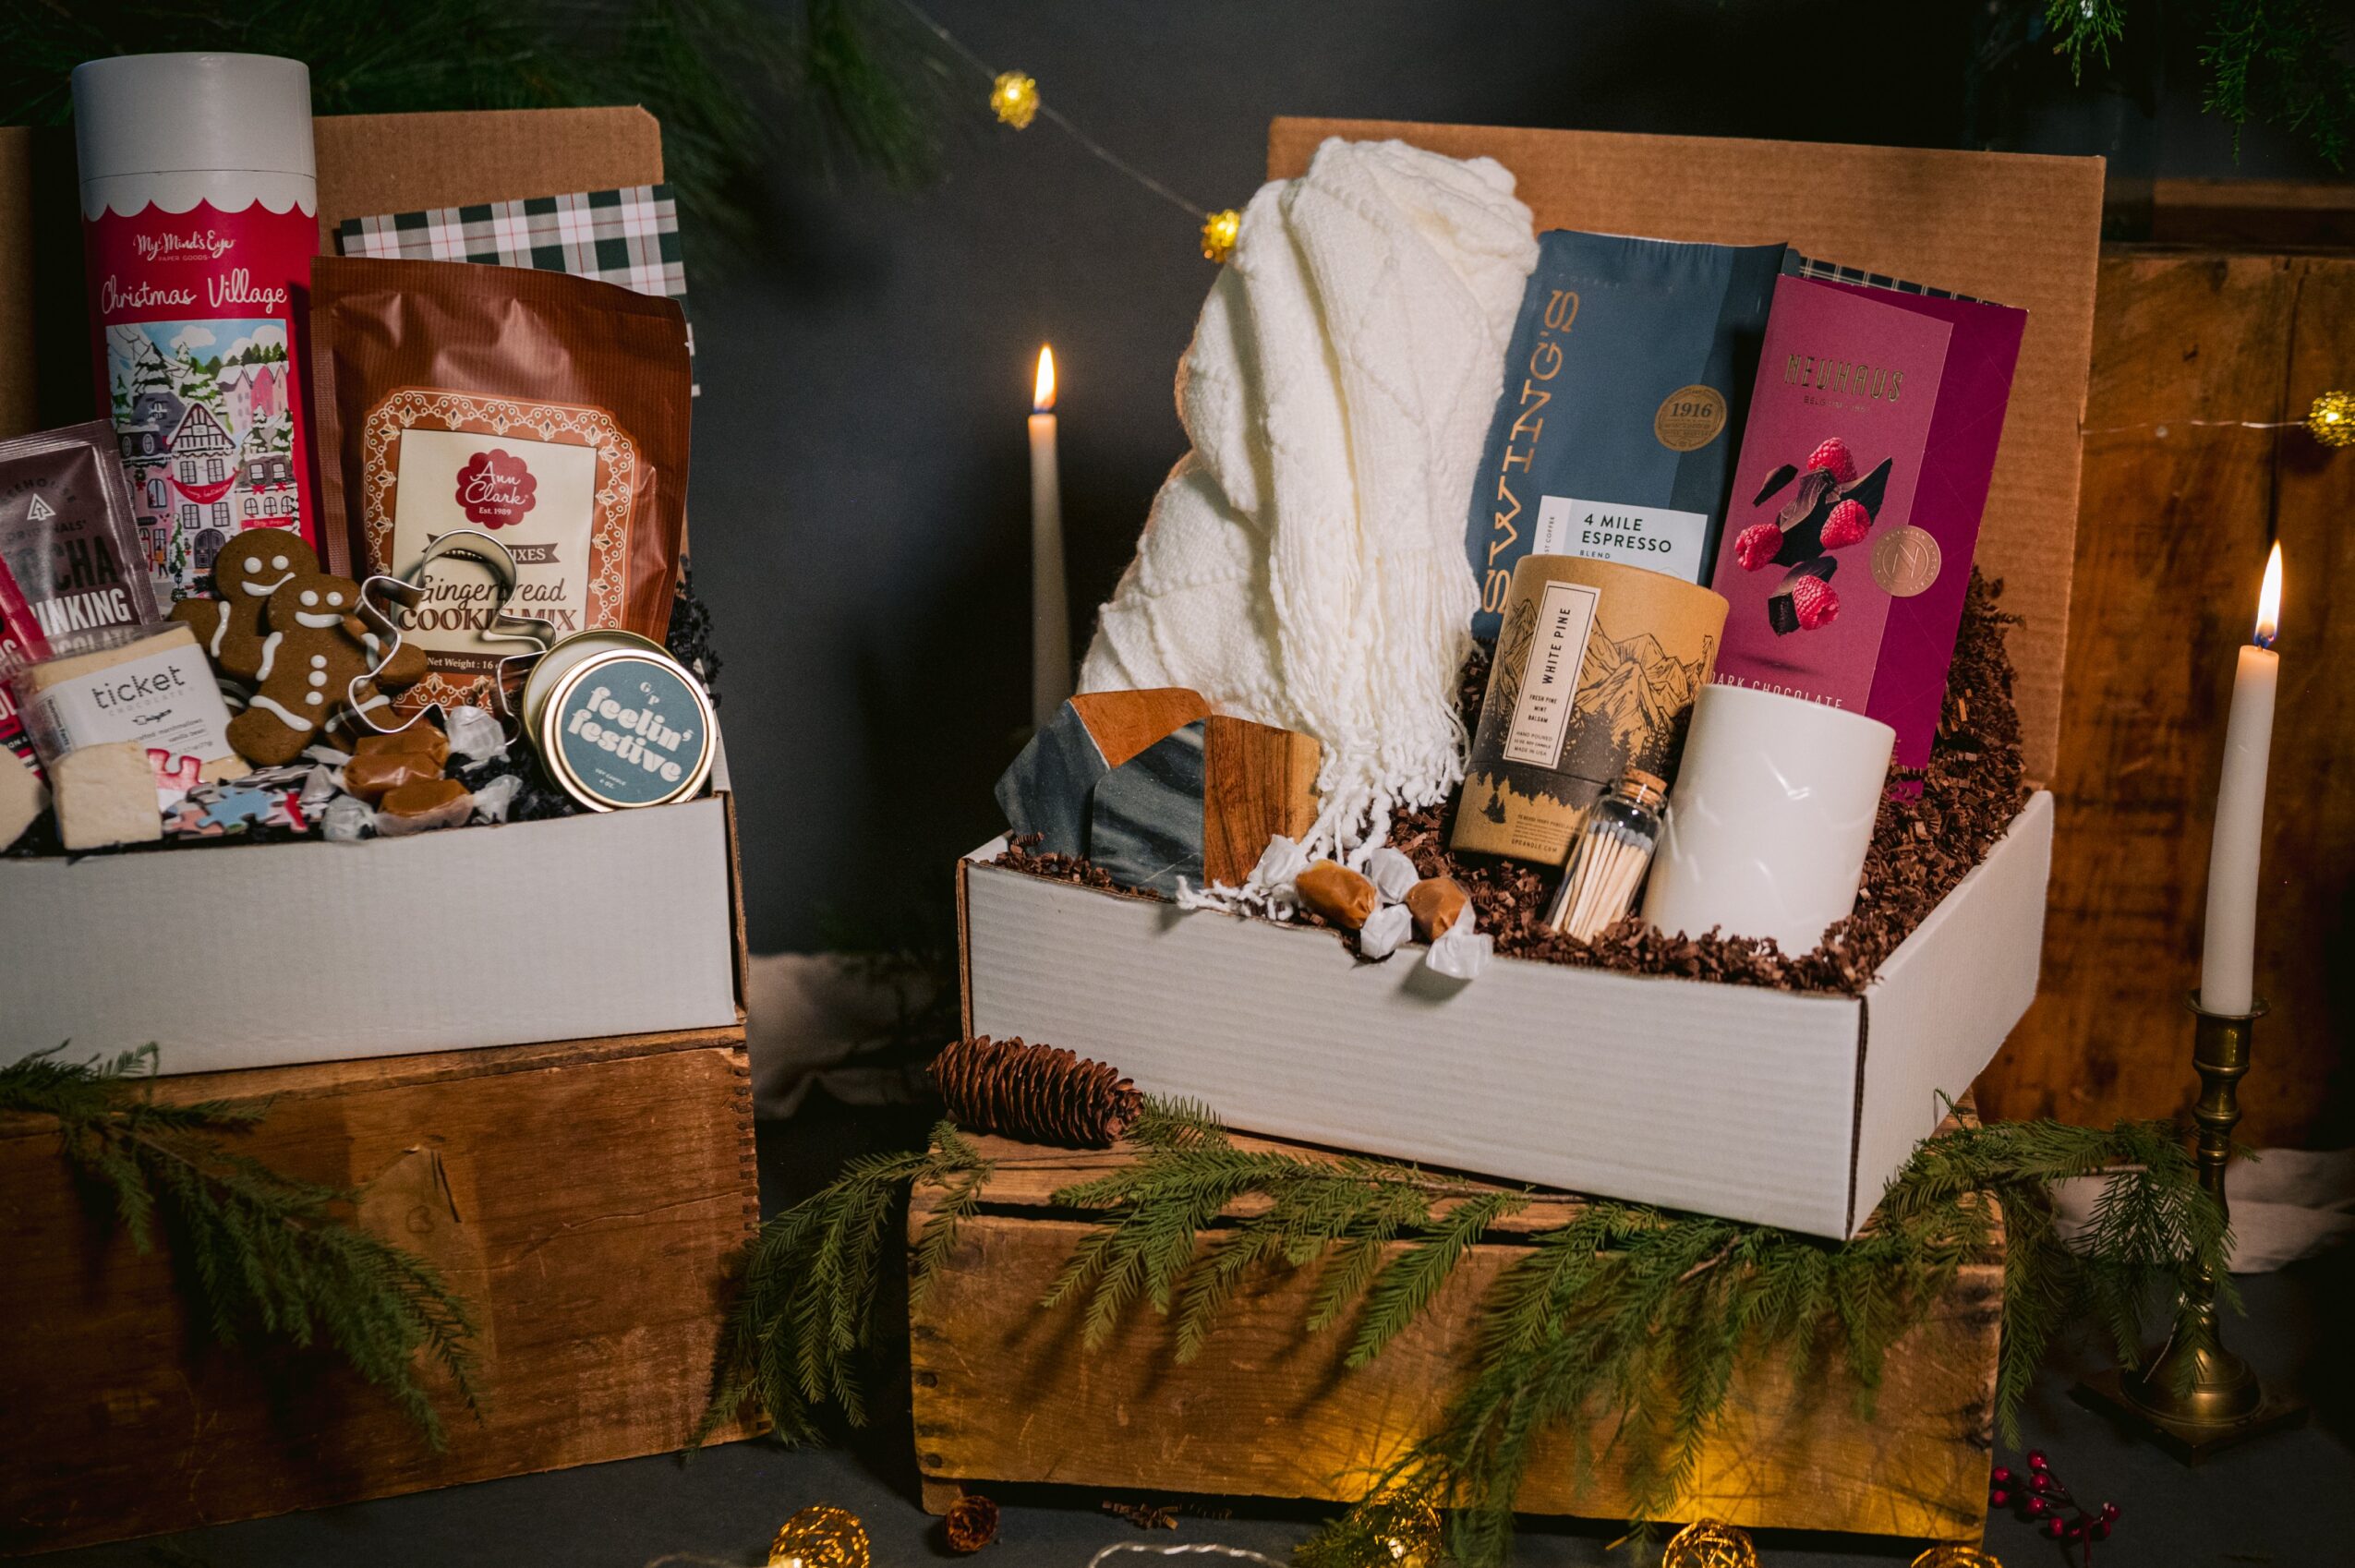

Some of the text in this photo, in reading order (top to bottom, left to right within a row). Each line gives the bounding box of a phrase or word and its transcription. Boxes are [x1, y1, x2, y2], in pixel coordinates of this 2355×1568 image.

[133, 229, 236, 261] My Mind's Eye
[102, 268, 287, 314] Christmas Village
[1784, 354, 1903, 403] NEUHAUS
[1670, 402, 1713, 417] 1916
[1482, 289, 1579, 613] SWING'S
[469, 461, 521, 485] Ann
[465, 480, 526, 505] Clark
[1584, 513, 1643, 532] 4 MILE
[510, 548, 546, 561] IXES
[1579, 549, 1611, 560] BLEND
[1581, 530, 1672, 553] ESPRESSO
[17, 536, 120, 602] OCHA
[35, 588, 132, 636] INKING
[428, 657, 442, 666] Net
[444, 658, 475, 669] Weight
[482, 660, 494, 669] 16
[1541, 608, 1571, 684] WHITE PINE
[91, 665, 186, 708] ticket
[586, 686, 694, 752] feelin'
[567, 708, 682, 783] festive
